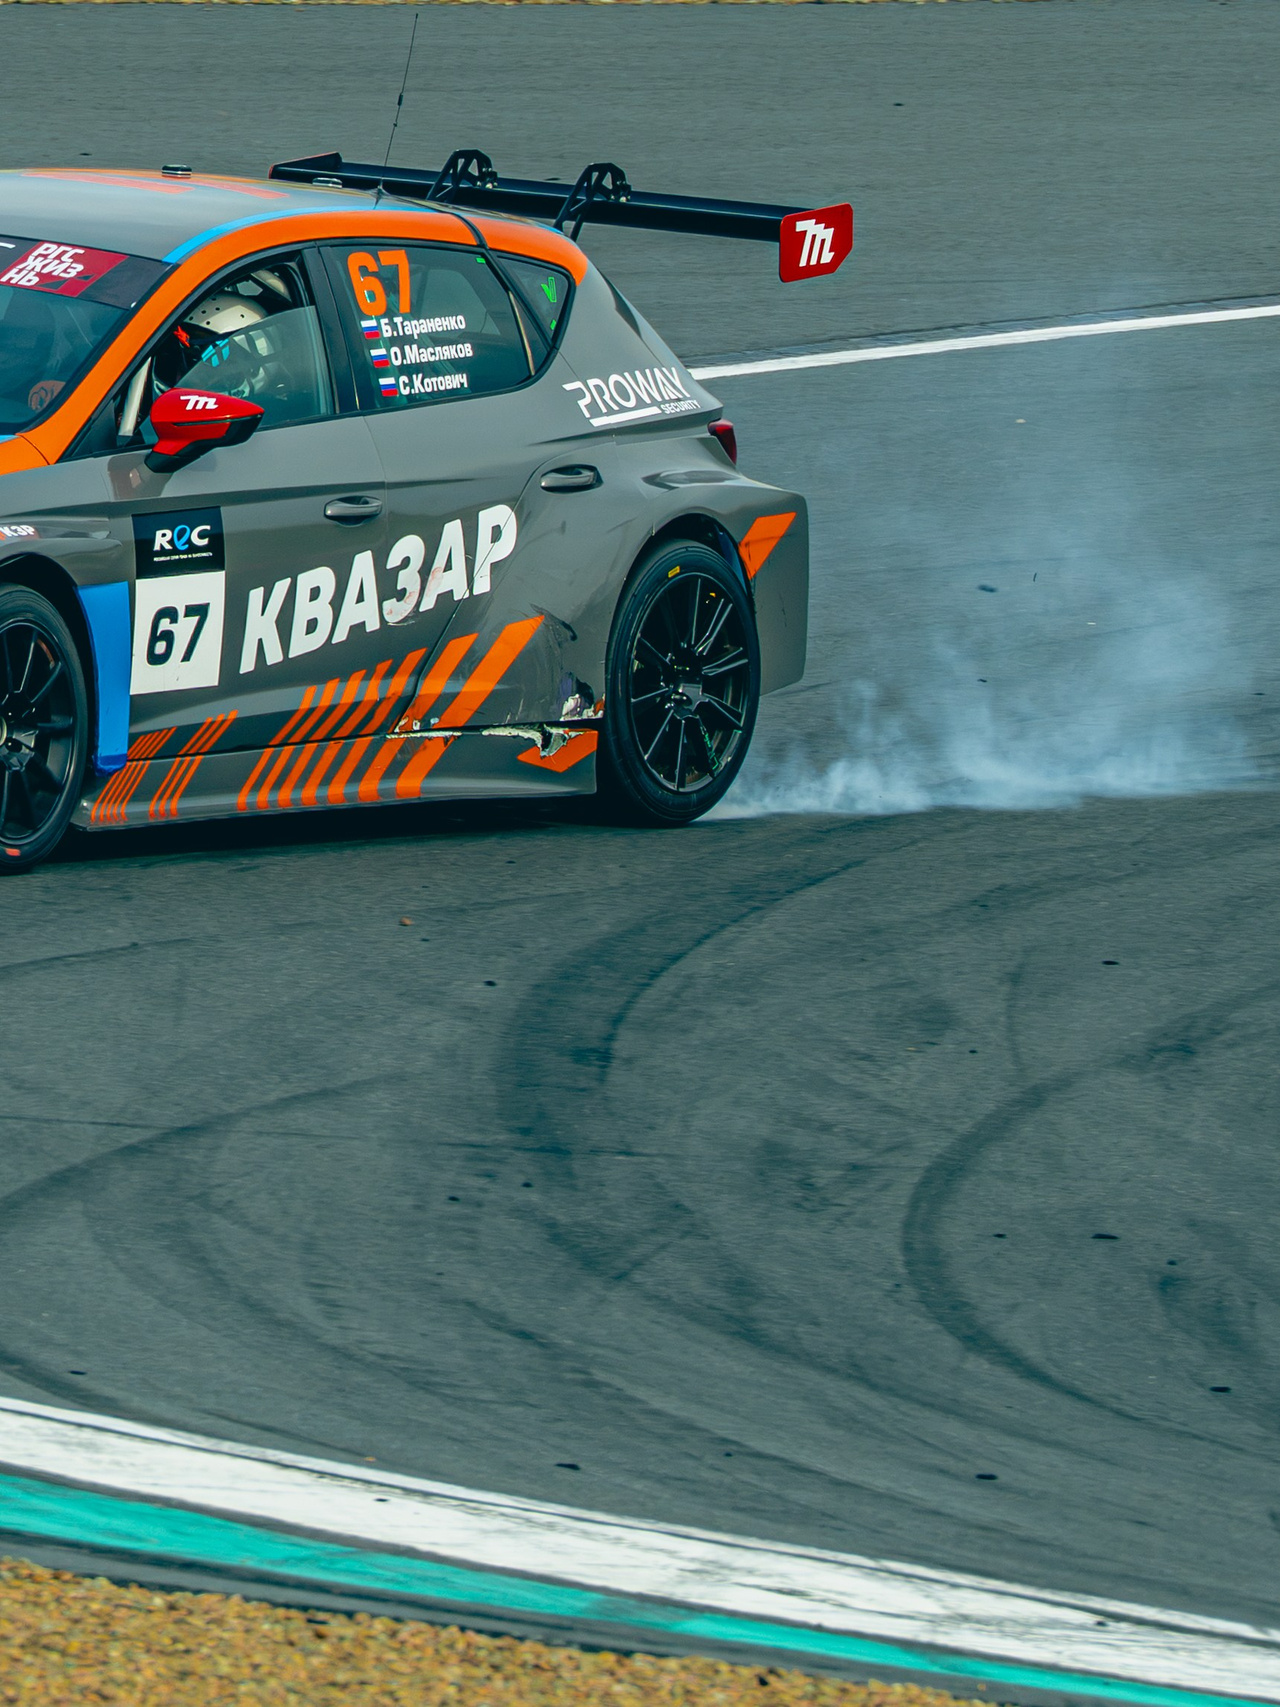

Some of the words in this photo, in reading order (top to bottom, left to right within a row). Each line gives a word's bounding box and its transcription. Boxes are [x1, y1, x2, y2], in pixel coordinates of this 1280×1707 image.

[31, 243, 85, 263] РГС
[0, 268, 40, 286] НЬ
[16, 255, 84, 278] ЖИЗ
[347, 249, 411, 316] 67
[380, 315, 466, 340] Б.Тараненко
[390, 343, 473, 366] О.Масляков
[398, 373, 468, 396] С.Котович
[562, 366, 690, 418] PROWAY
[661, 399, 701, 414] SECURITY
[239, 504, 517, 674] КВАЗАР
[146, 602, 210, 666] 67
